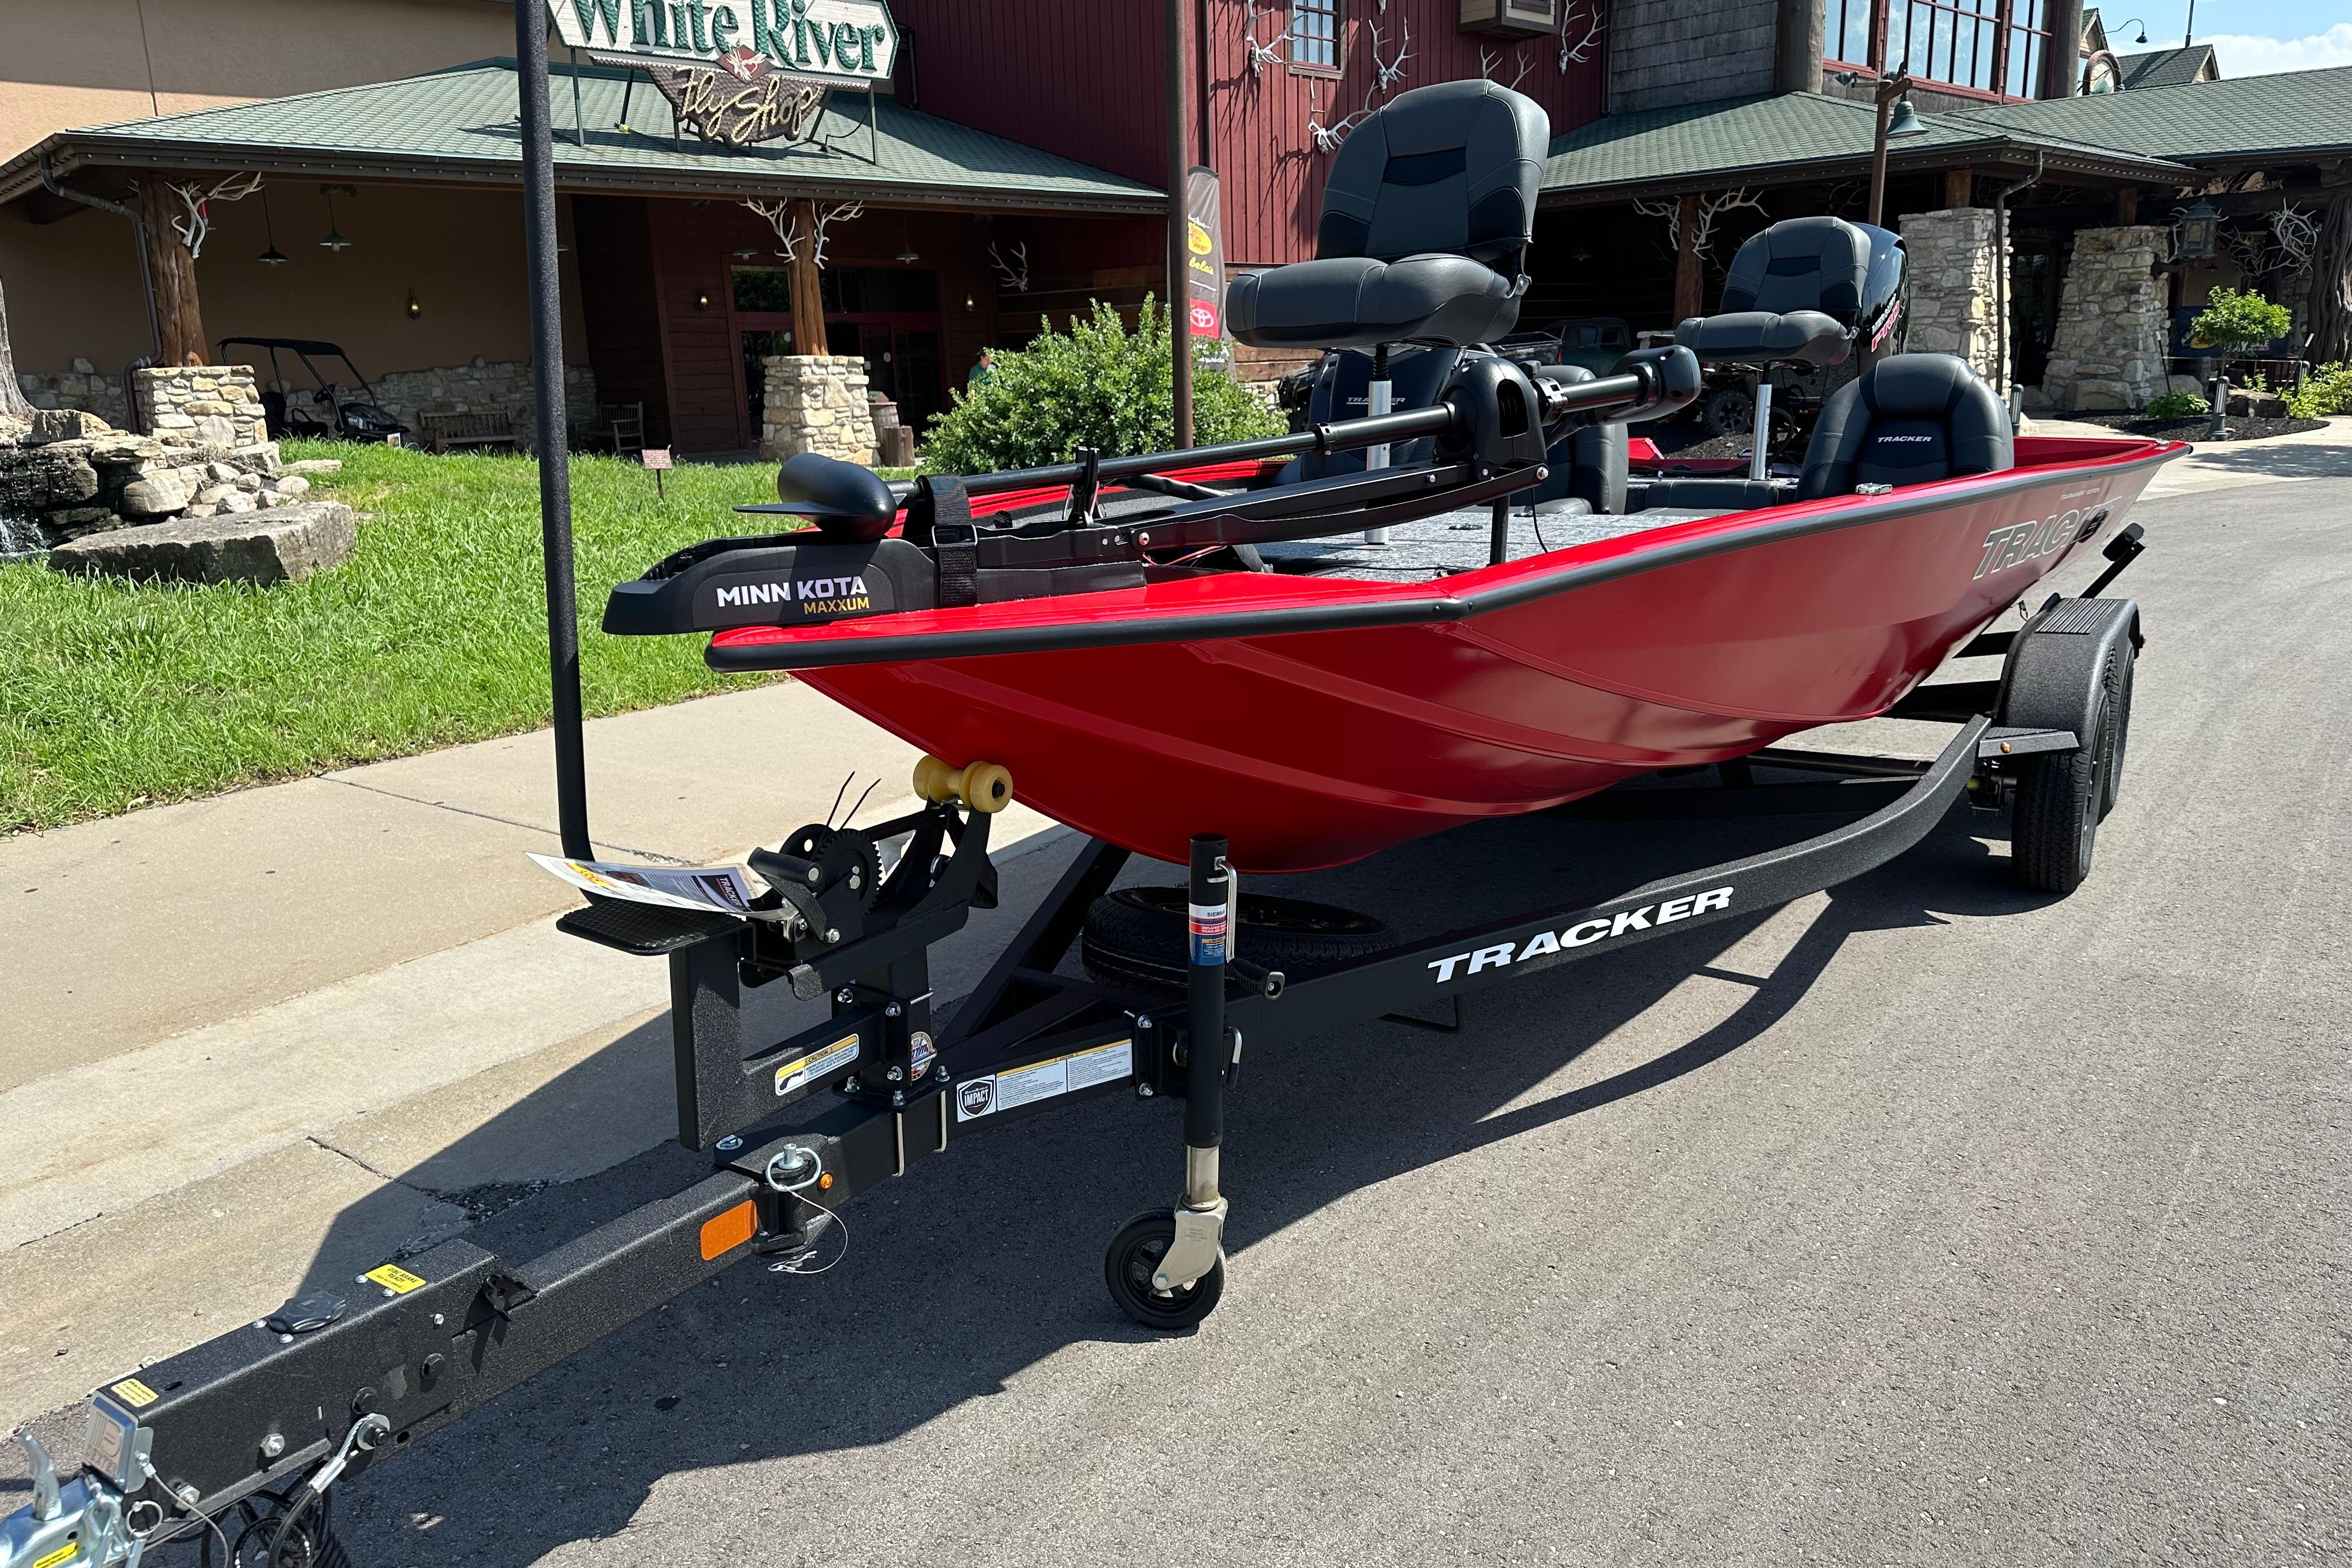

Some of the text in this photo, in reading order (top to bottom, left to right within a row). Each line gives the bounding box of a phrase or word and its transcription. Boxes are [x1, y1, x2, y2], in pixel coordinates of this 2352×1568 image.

[570, 0, 885, 70] White River
[675, 67, 821, 142] Fly Shop
[716, 576, 868, 607] MINN KOTA
[804, 597, 870, 615] MAXXUM
[719, 877, 742, 906] TRACKER
[1427, 886, 1734, 984] TRACKER
[808, 1050, 828, 1063] CAUTION
[964, 1089, 989, 1107] IMPACT
[387, 1273, 406, 1282] READY
[400, 1273, 418, 1283] BRAKE
